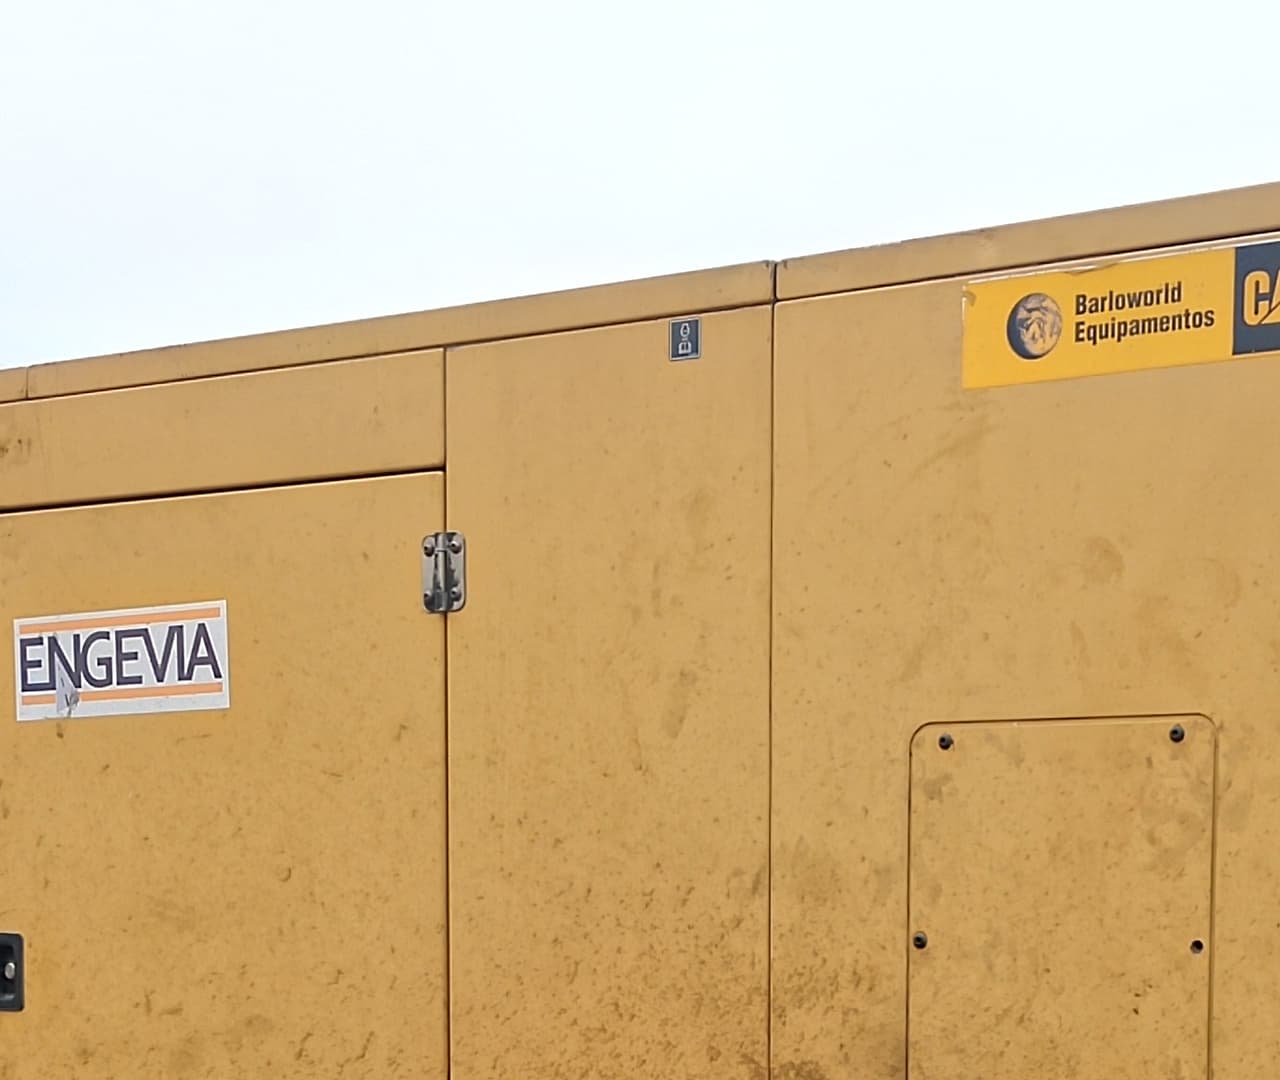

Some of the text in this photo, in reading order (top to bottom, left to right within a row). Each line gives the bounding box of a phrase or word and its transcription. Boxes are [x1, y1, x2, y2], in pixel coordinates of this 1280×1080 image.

[1074, 281, 1183, 316] Barloworld
[1074, 307, 1215, 346] Equipamentos
[19, 622, 223, 693] ENGEVIA
